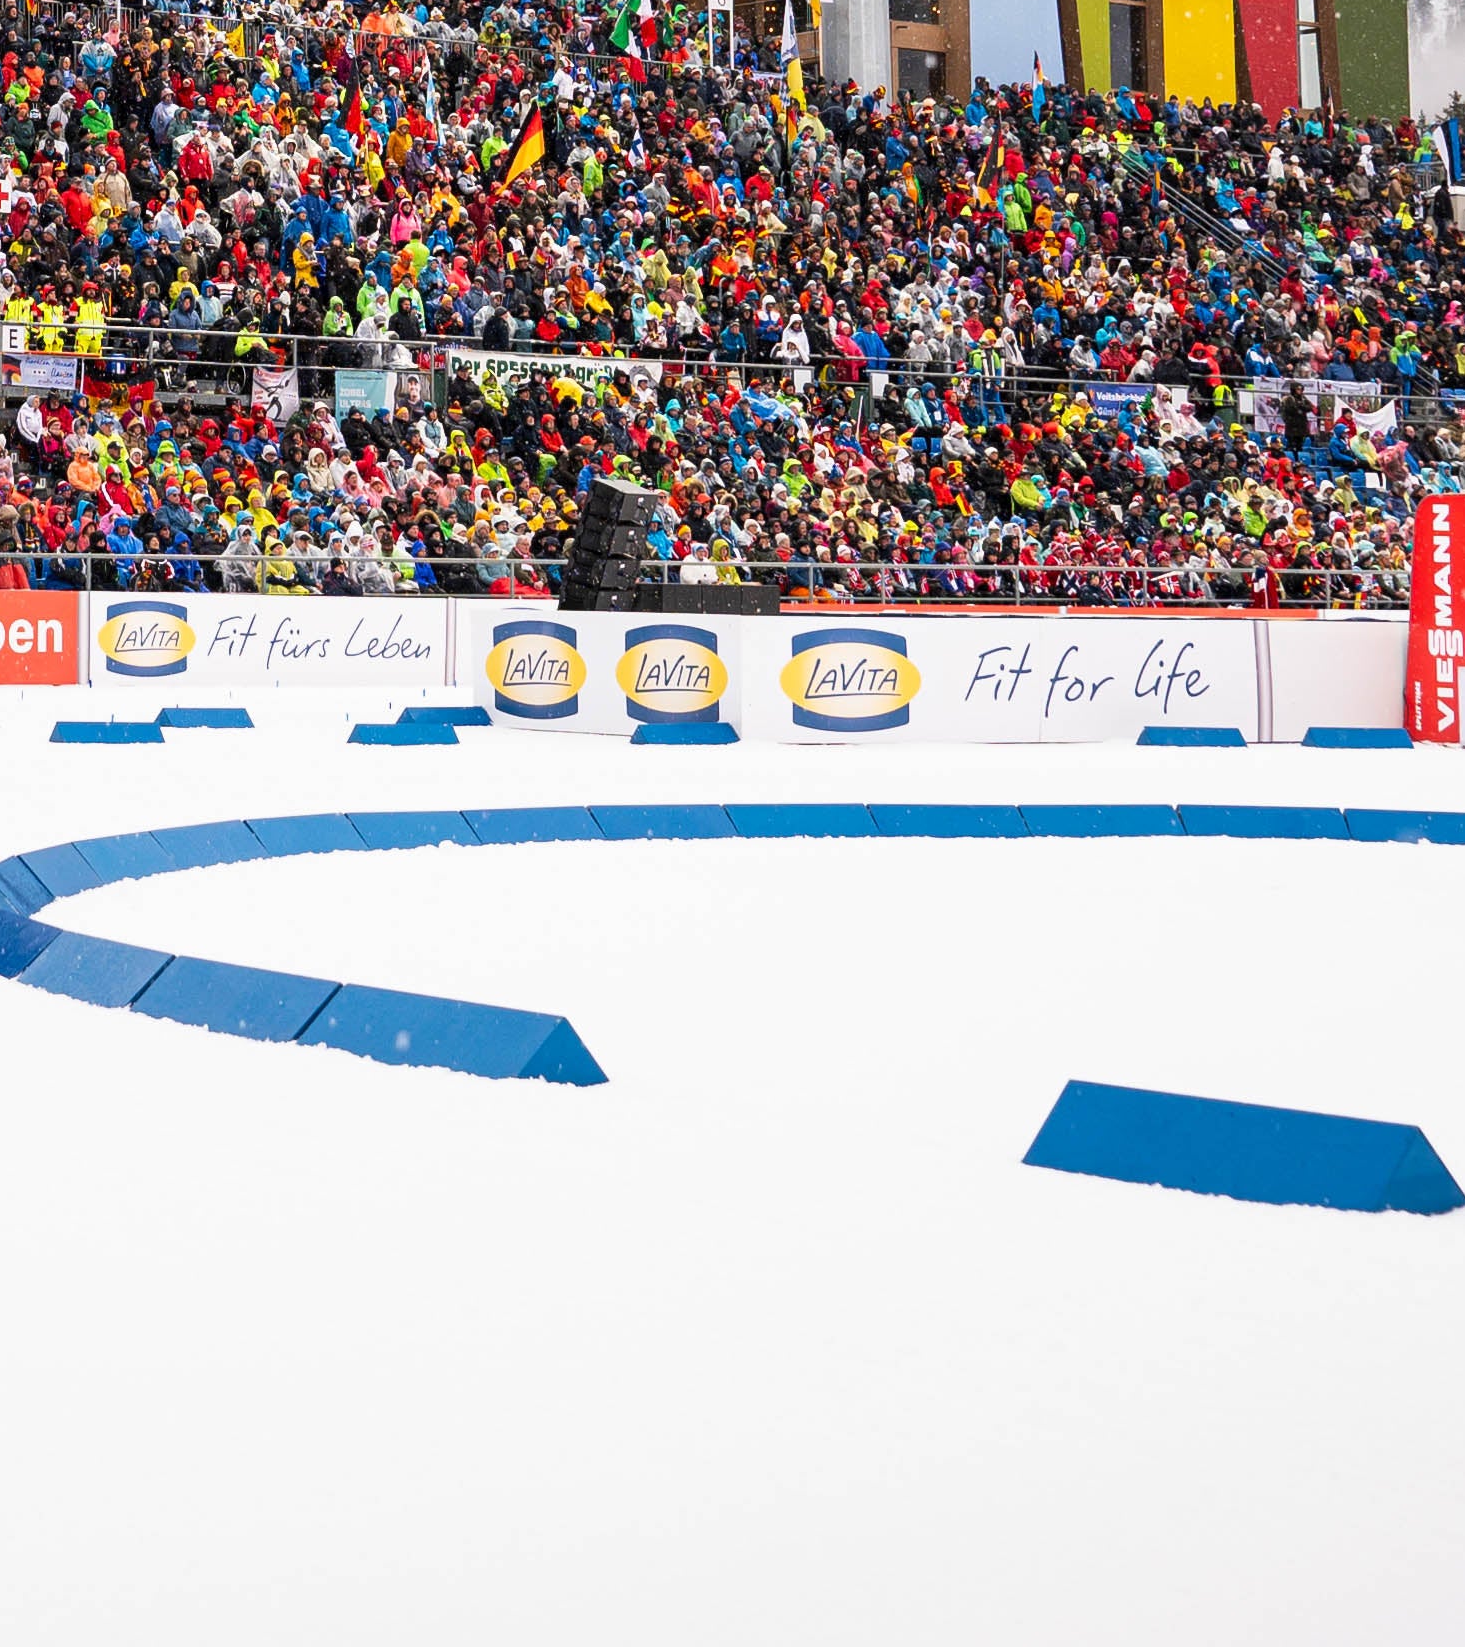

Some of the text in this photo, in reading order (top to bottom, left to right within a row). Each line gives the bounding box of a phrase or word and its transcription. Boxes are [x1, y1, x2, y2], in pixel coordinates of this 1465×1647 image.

[9, 328, 19, 349] E
[451, 356, 481, 376] Der
[207, 614, 432, 671] Fit fürs Leben
[1428, 503, 1464, 732] VIESSMANN
[965, 639, 1210, 718] Fit for life
